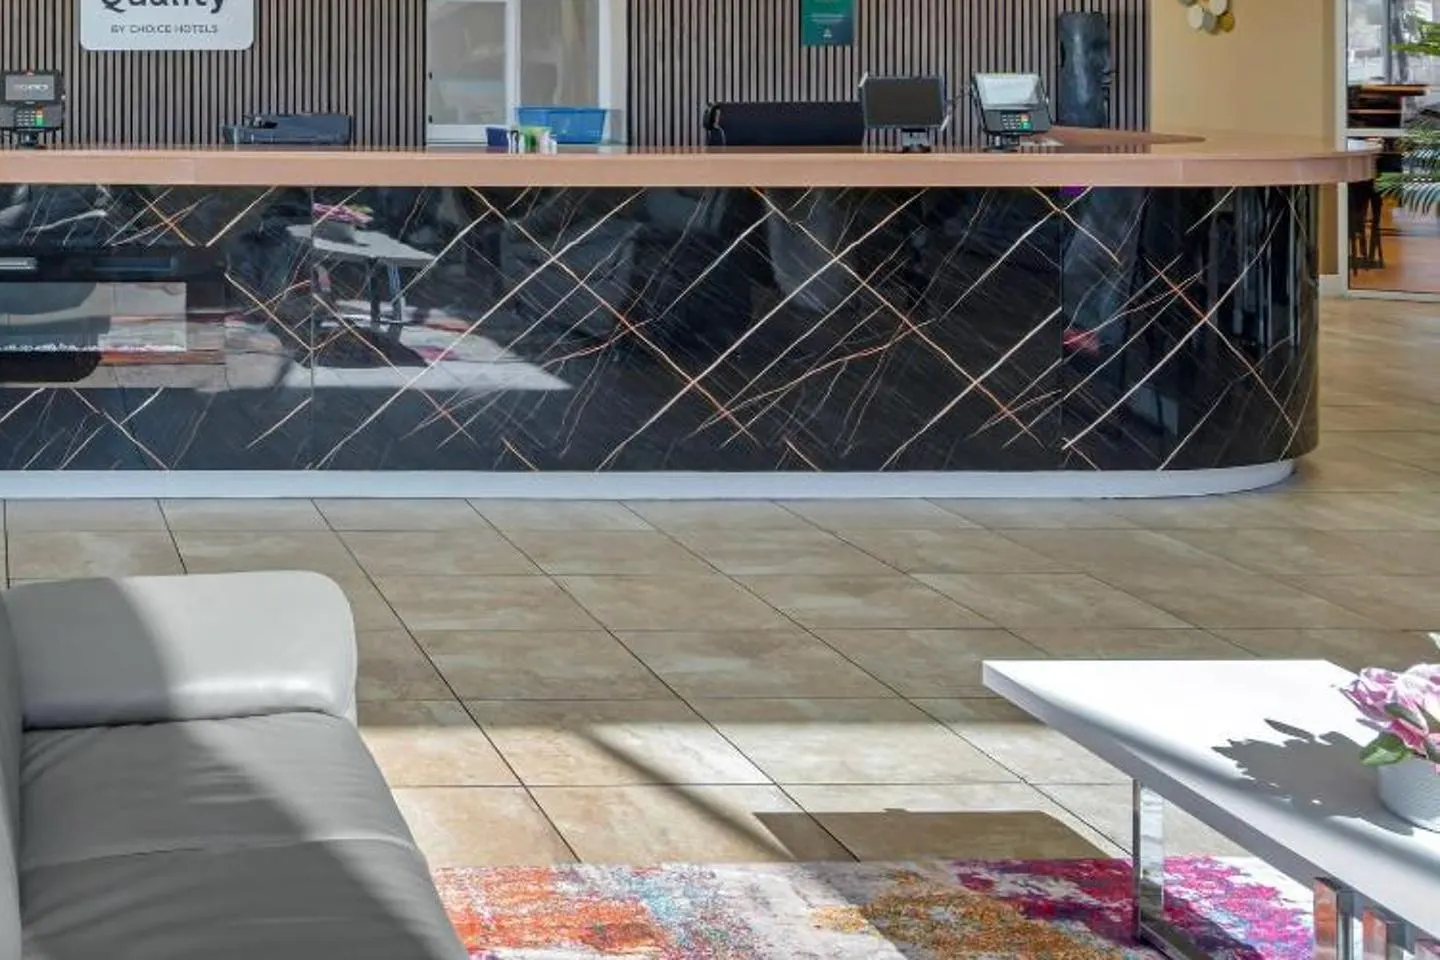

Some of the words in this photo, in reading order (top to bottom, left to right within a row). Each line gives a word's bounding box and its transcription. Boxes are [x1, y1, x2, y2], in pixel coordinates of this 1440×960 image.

[110, 24, 125, 34] BY
[130, 24, 172, 34] CHOICE
[175, 24, 219, 34] HOTELS
